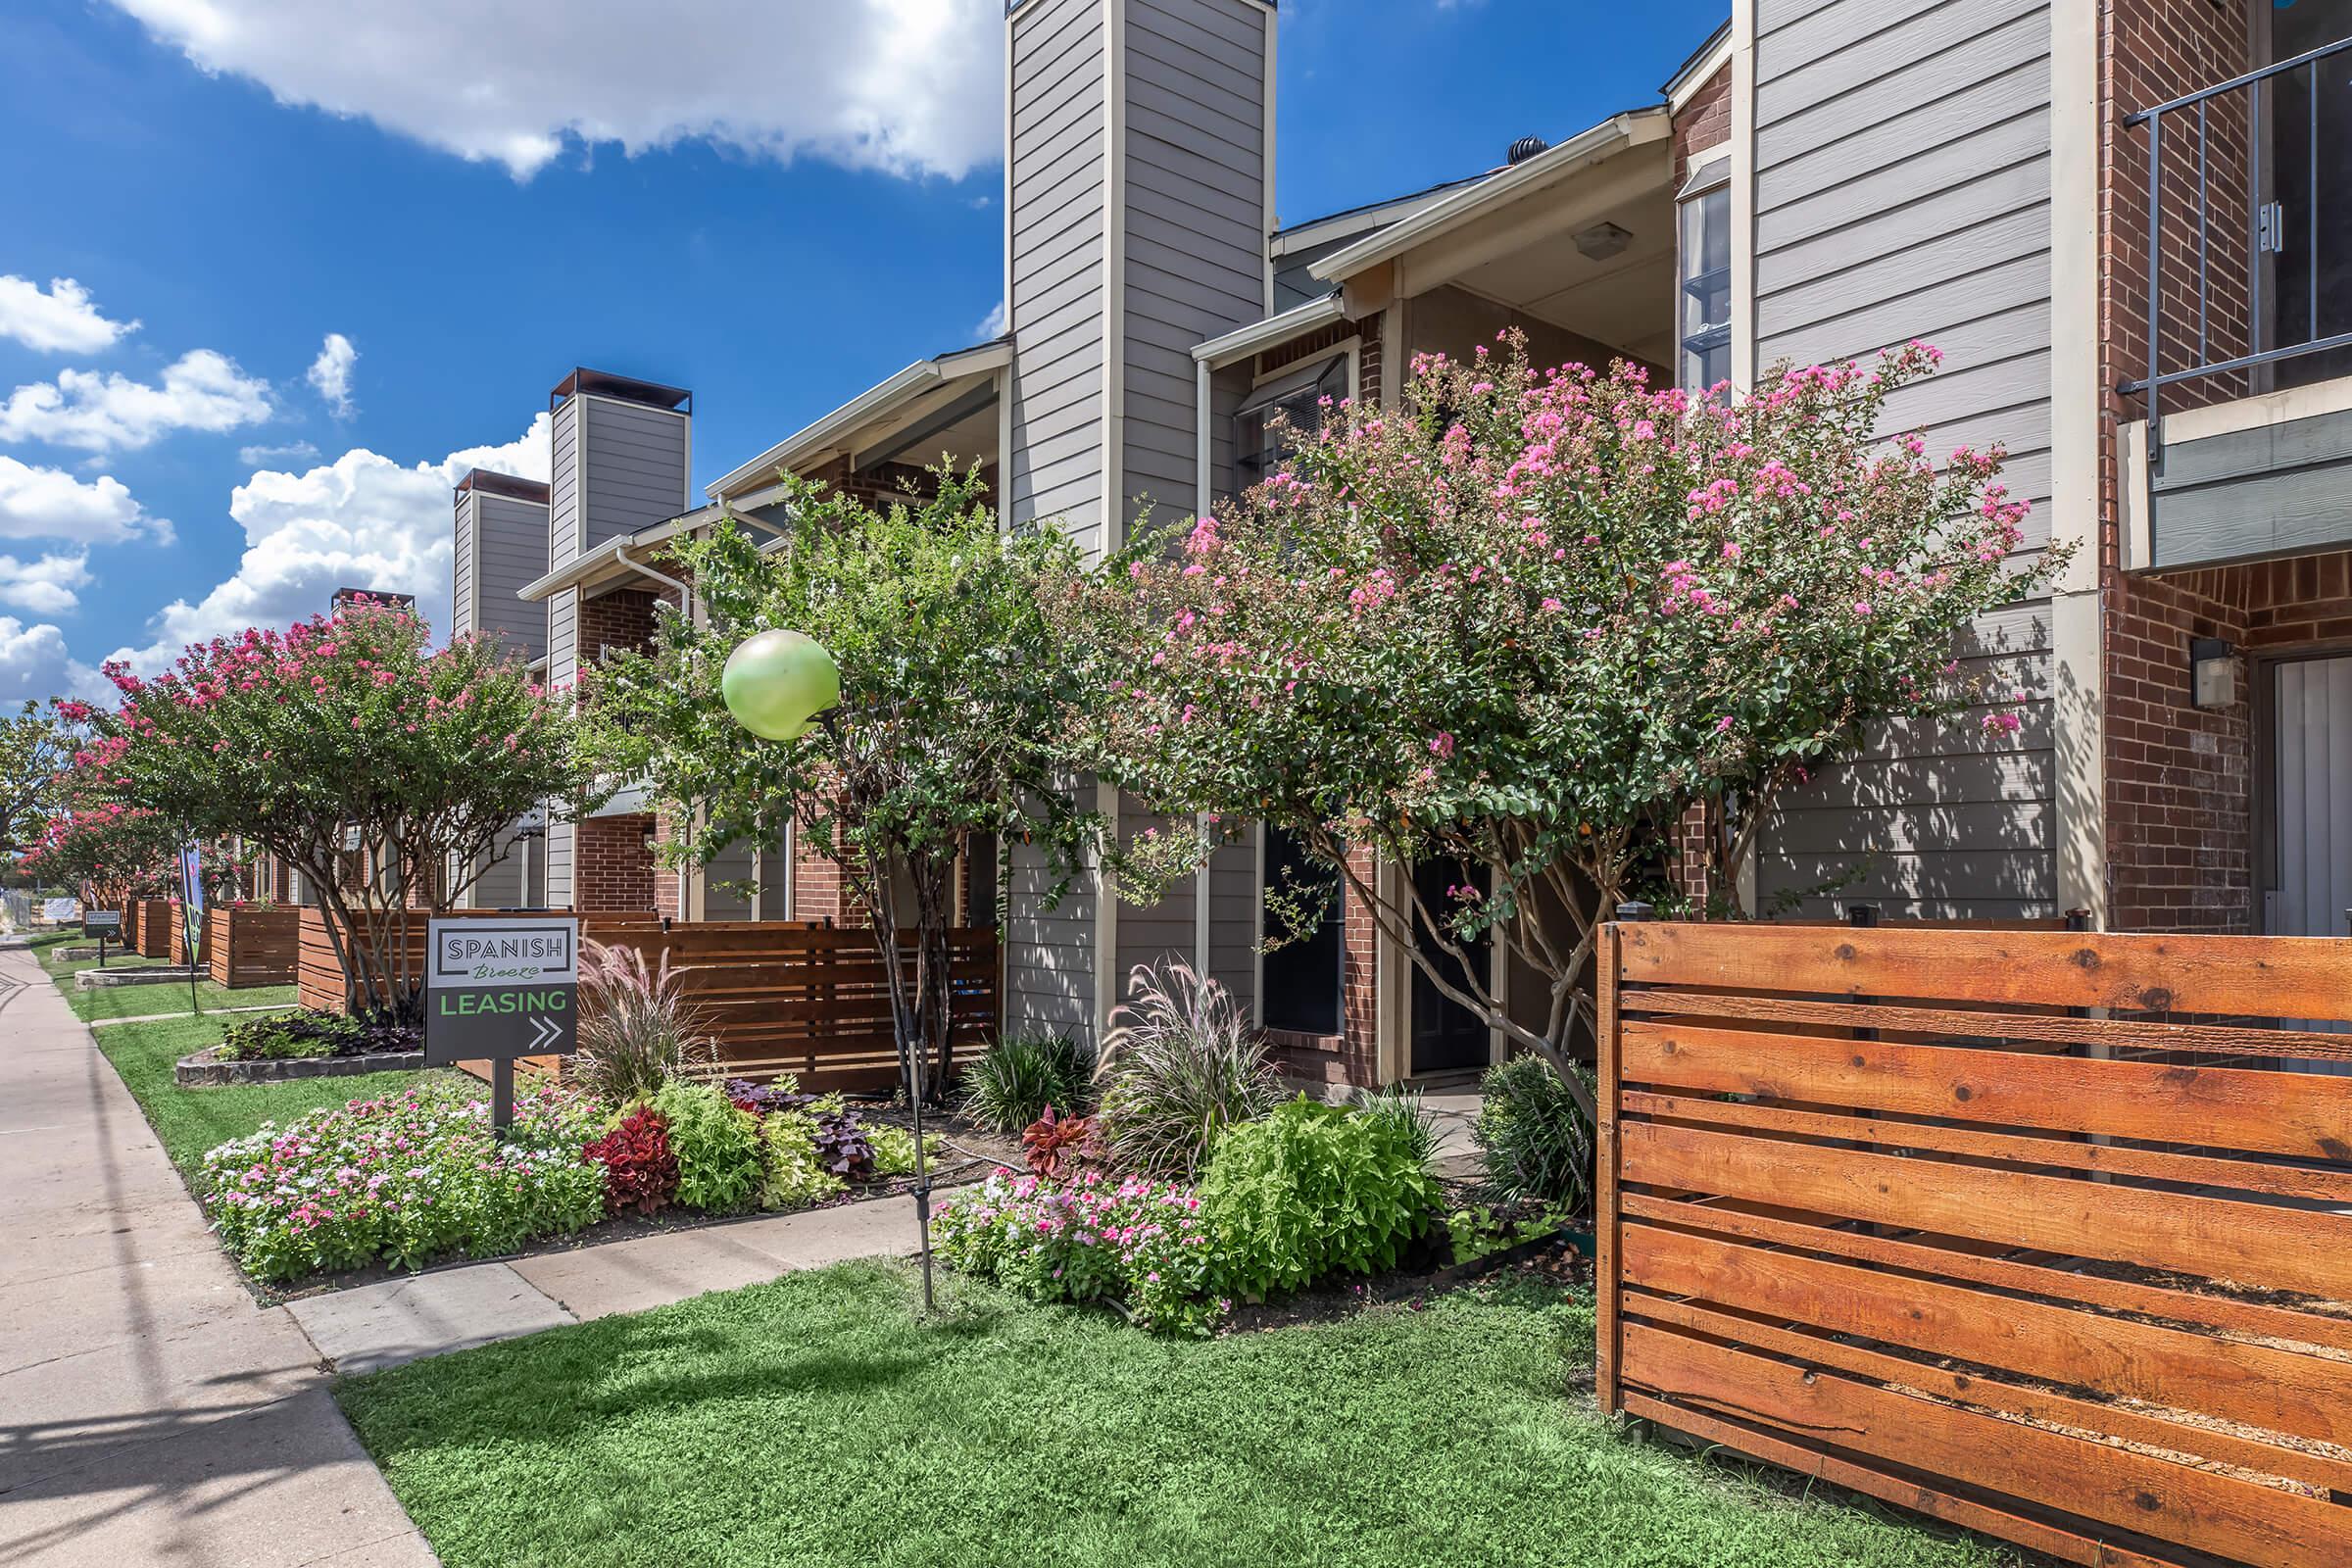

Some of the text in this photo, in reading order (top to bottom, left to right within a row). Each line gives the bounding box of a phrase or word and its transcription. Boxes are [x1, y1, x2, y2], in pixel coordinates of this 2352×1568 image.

[448, 938, 563, 960] SPANISH
[472, 963, 540, 980] Breeze
[440, 991, 566, 1015] LEASING
